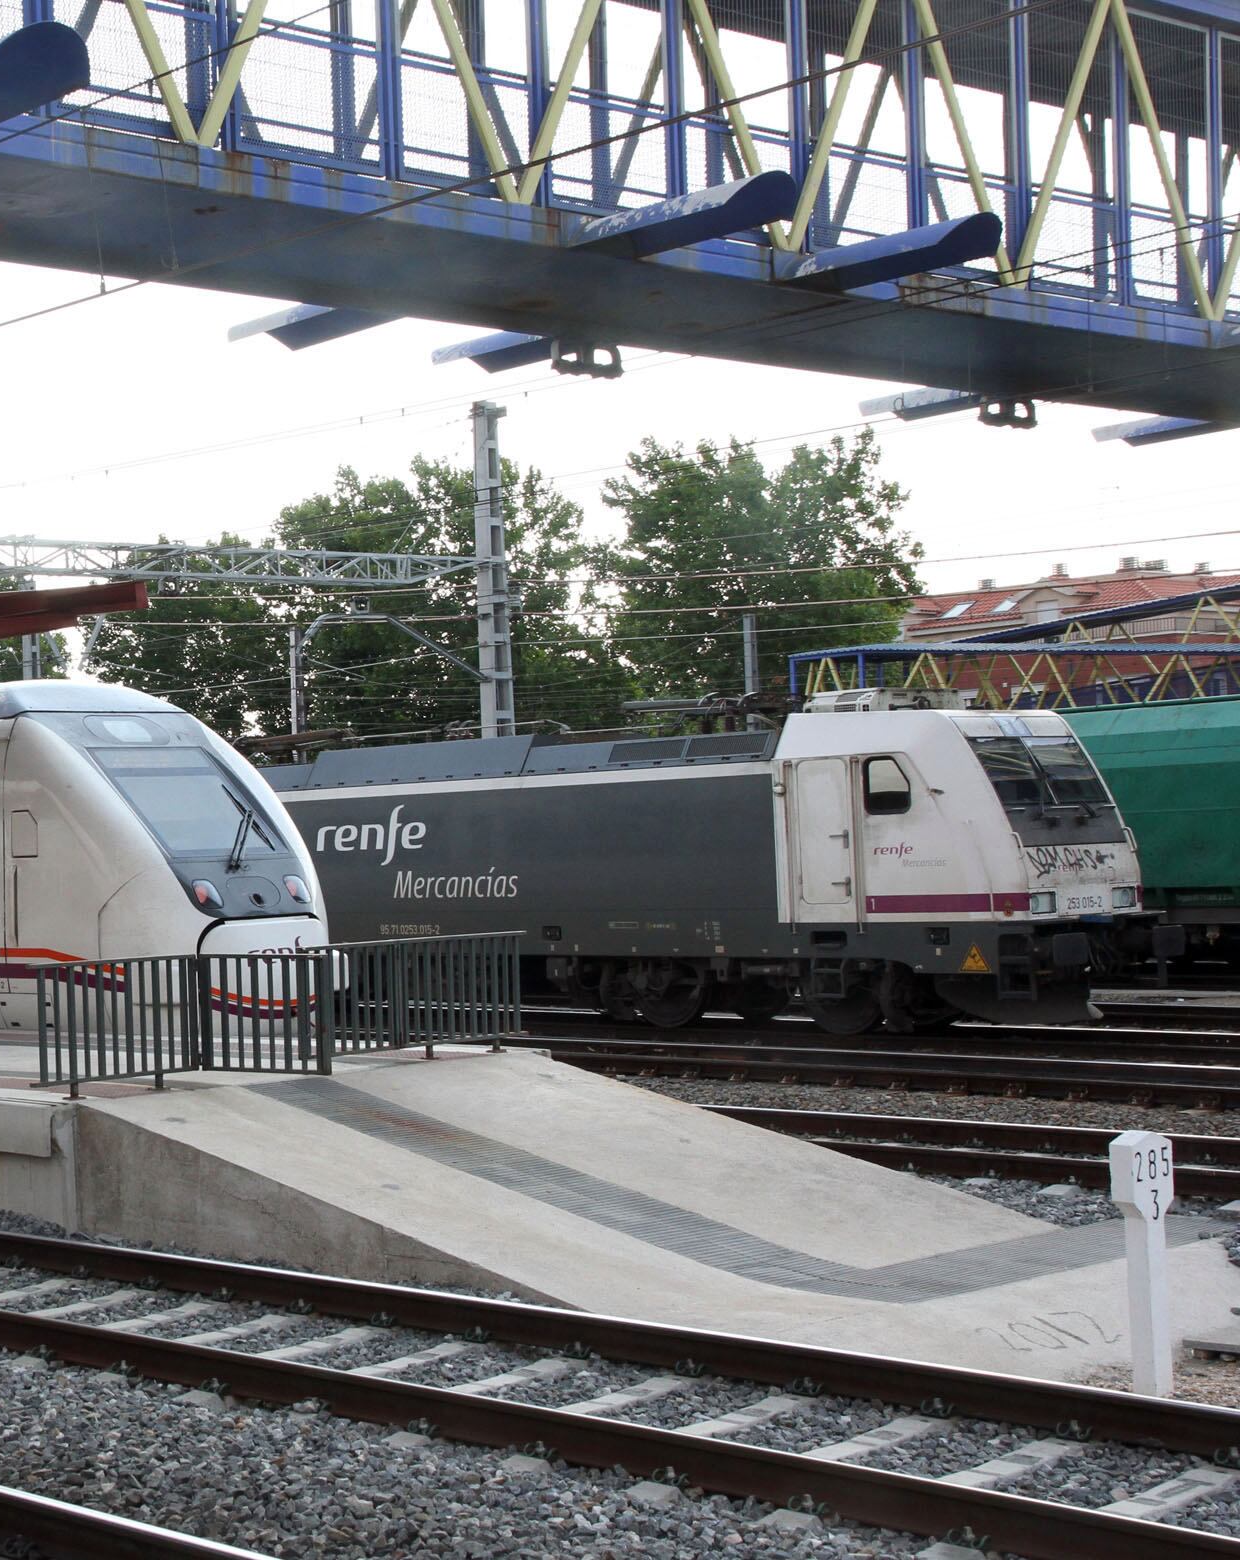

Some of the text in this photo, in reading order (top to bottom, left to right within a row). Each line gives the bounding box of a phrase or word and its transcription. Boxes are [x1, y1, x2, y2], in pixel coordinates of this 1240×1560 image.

[316, 804, 427, 866] renfe
[873, 841, 914, 858] renfe
[393, 866, 519, 899] Mercancías
[871, 898, 876, 911] 1
[1066, 896, 1103, 910] 253 015-2
[1134, 1146, 1170, 1183] 285
[1150, 1189, 1160, 1221] 3
